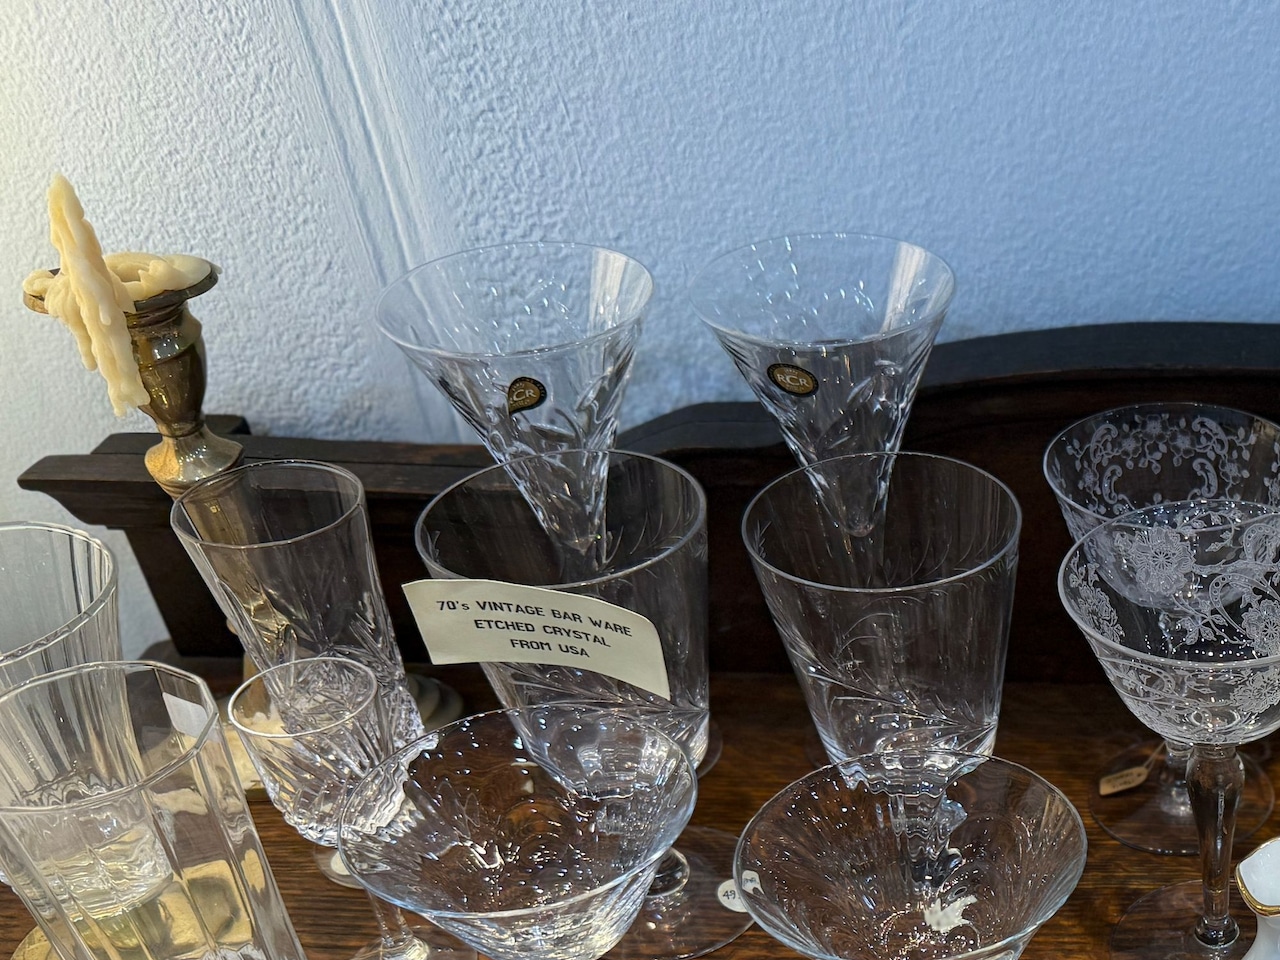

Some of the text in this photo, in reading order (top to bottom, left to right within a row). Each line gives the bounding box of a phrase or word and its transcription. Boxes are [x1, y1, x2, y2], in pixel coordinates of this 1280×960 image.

[776, 373, 811, 388] RCR
[511, 388, 538, 403] CR
[436, 600, 633, 637] 70's VINTAGE BAR WARE
[474, 619, 611, 648] ETCHED CRYSTAL
[510, 638, 590, 658] FROM USA
